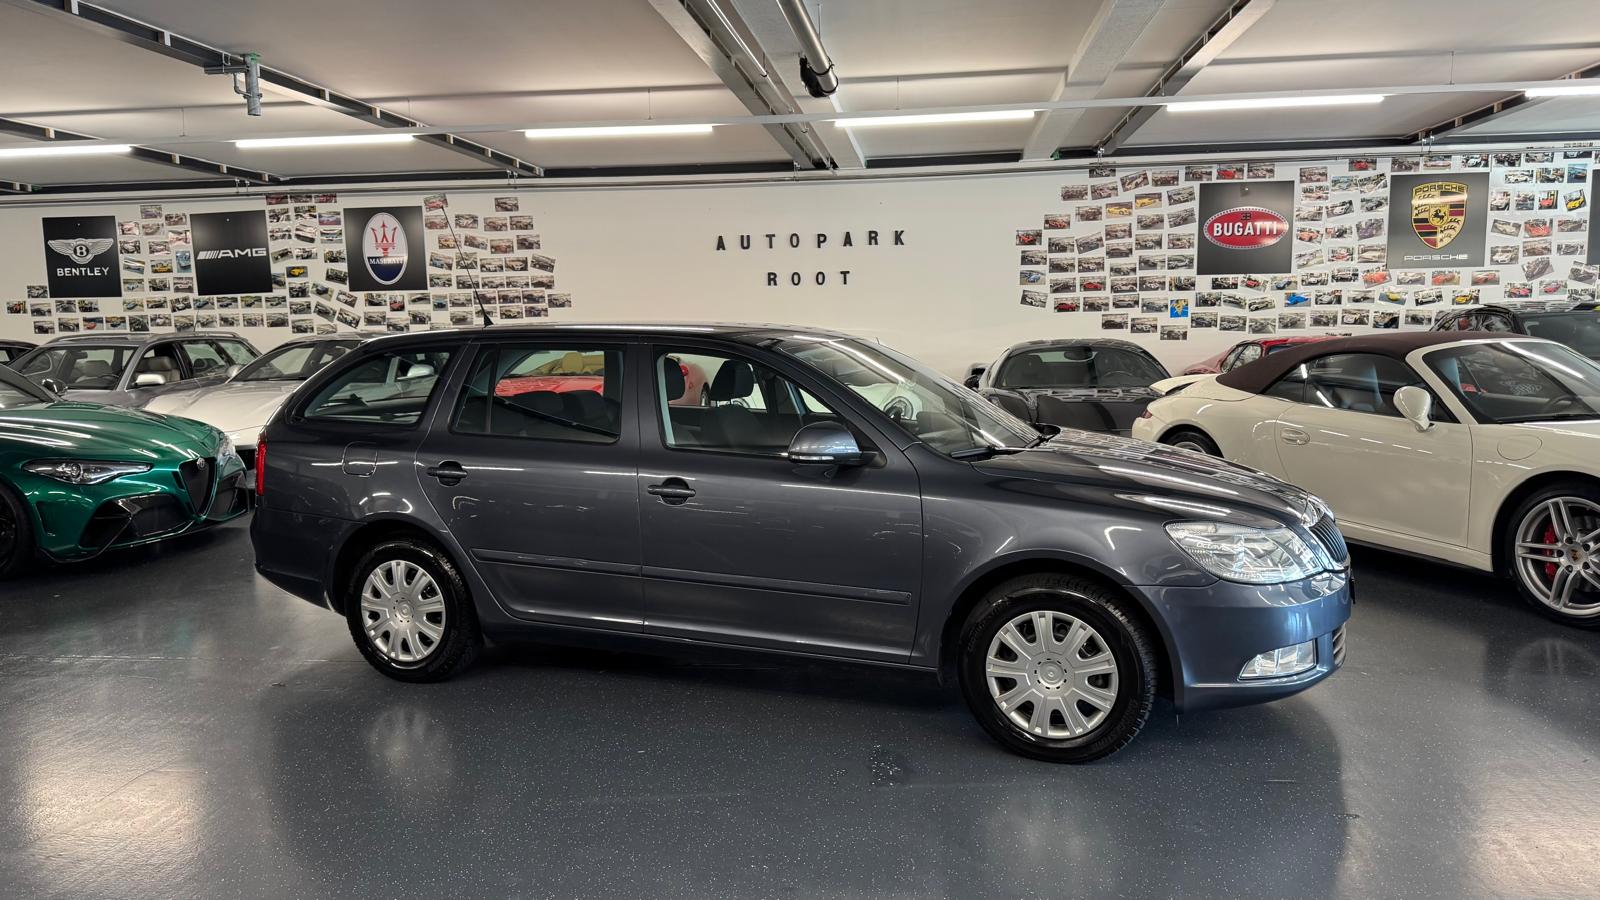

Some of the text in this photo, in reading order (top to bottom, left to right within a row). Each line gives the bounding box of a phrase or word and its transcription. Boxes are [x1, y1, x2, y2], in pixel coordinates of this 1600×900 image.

[1414, 184, 1466, 195] PORSCHE
[1213, 221, 1278, 236] BUGATTI
[716, 230, 904, 250] AUTOPARK
[218, 248, 267, 259] AMG
[56, 267, 109, 276] BENTLEY
[767, 271, 851, 286] ROOT
